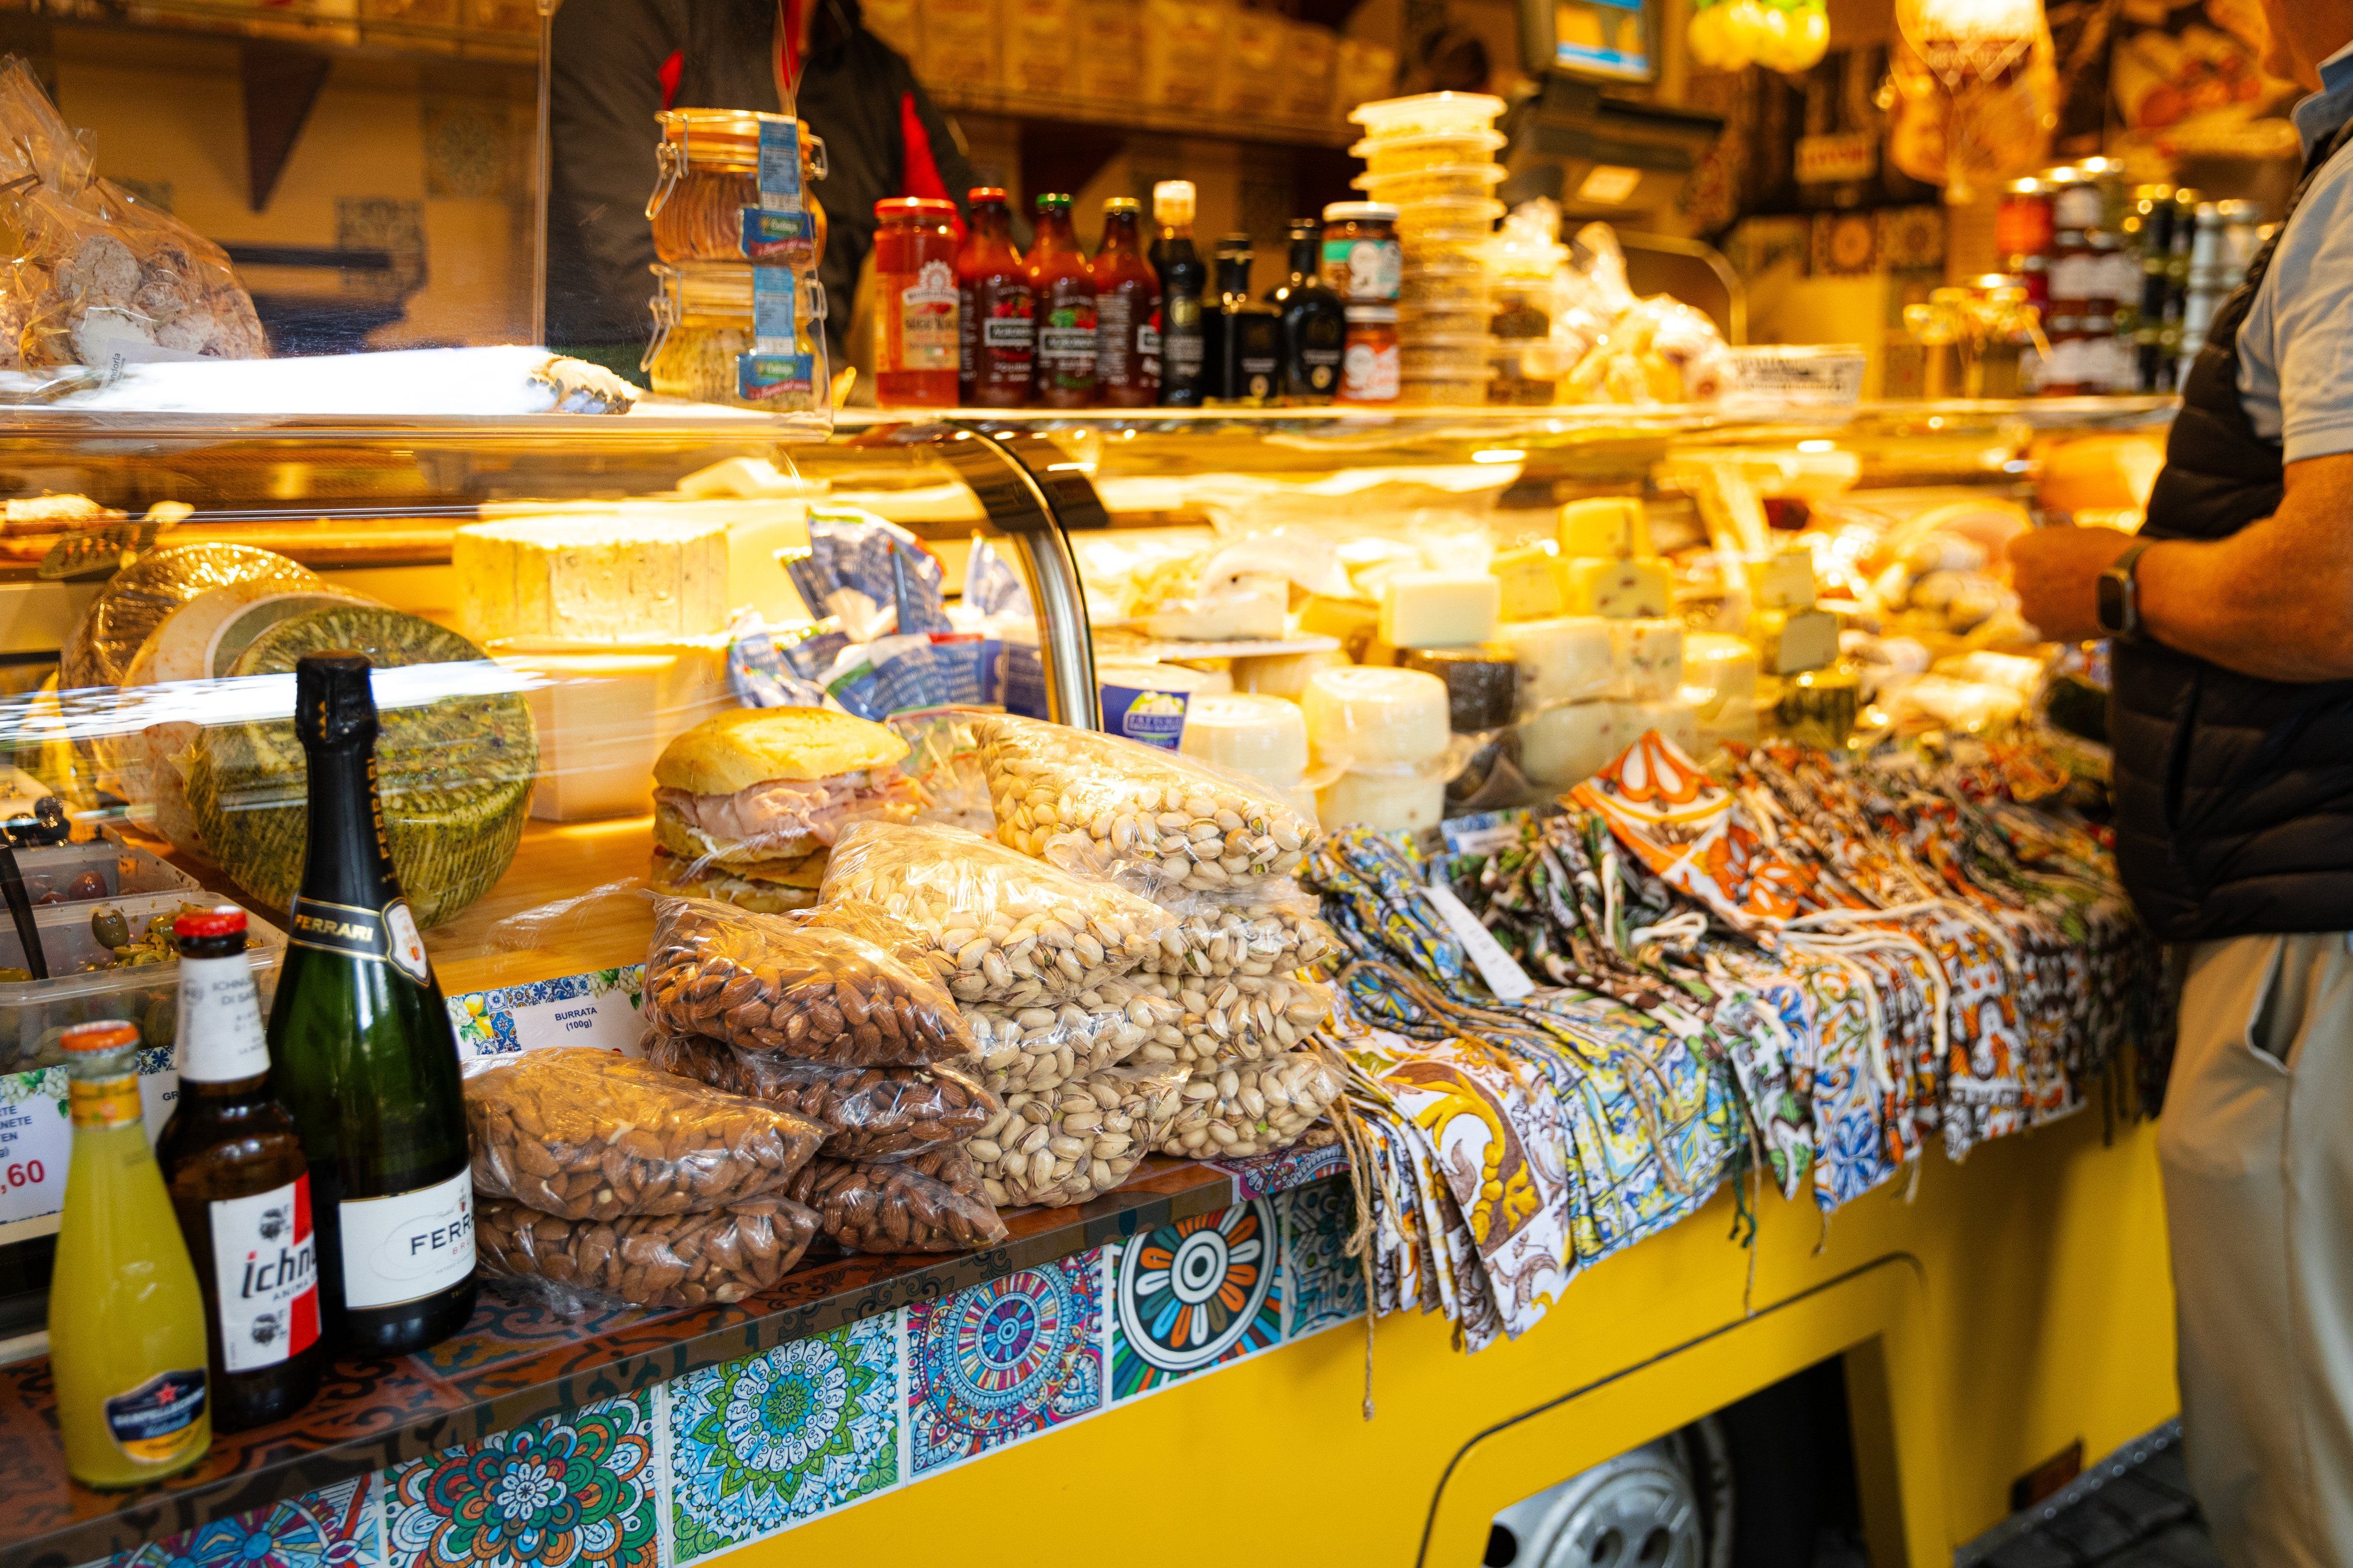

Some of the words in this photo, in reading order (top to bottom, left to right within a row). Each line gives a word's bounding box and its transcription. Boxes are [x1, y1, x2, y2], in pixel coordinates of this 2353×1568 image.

[366, 758, 391, 860] FERRARI
[294, 913, 375, 943] FERRARI
[555, 1007, 598, 1021] BURRATA
[566, 1018, 592, 1032] (100g)
[0, 1115, 33, 1130] NETE
[0, 1132, 18, 1143] EN
